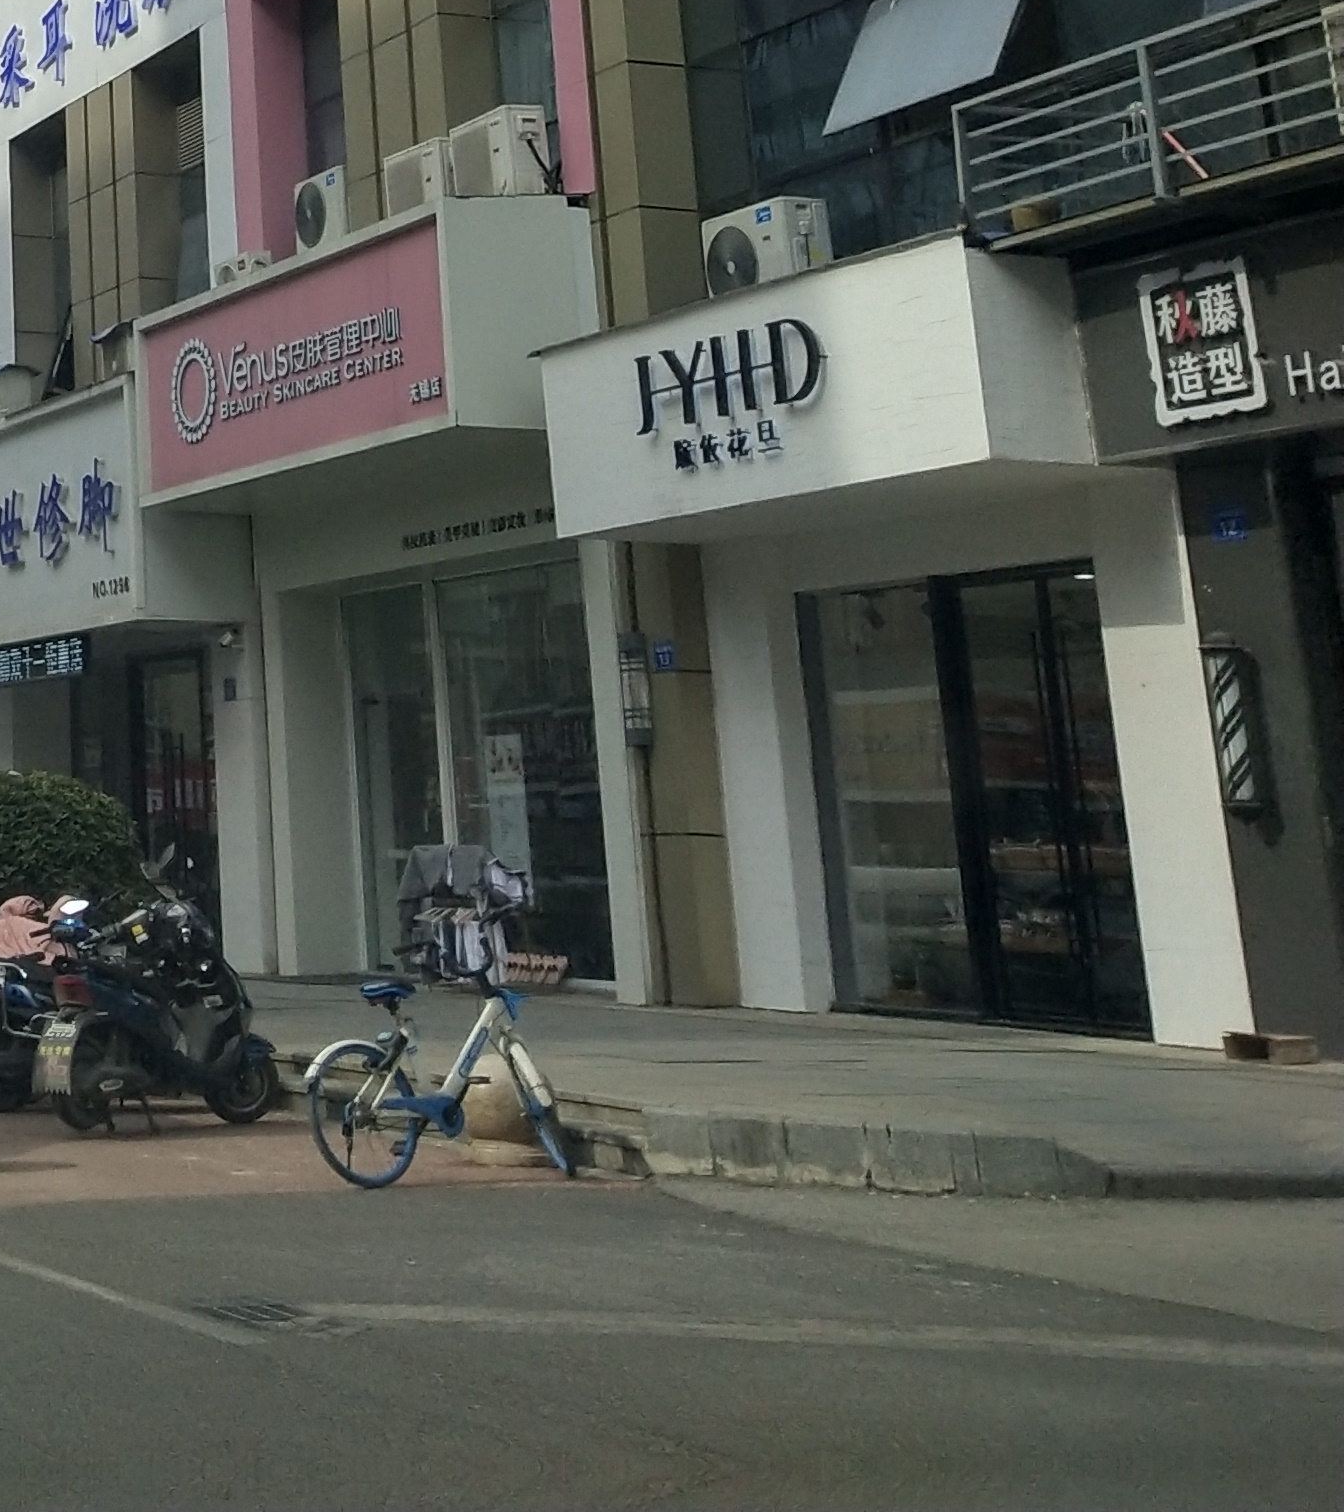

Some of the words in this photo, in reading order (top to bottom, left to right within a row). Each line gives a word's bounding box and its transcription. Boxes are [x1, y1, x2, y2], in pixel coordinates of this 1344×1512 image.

[1154, 281, 1239, 344] 秋藤
[218, 390, 269, 421] BEAUTY
[272, 366, 341, 404] SKINCARE
[343, 346, 405, 381] CENTER
[1166, 341, 1249, 404] 造型
[1283, 343, 1344, 397] Ha
